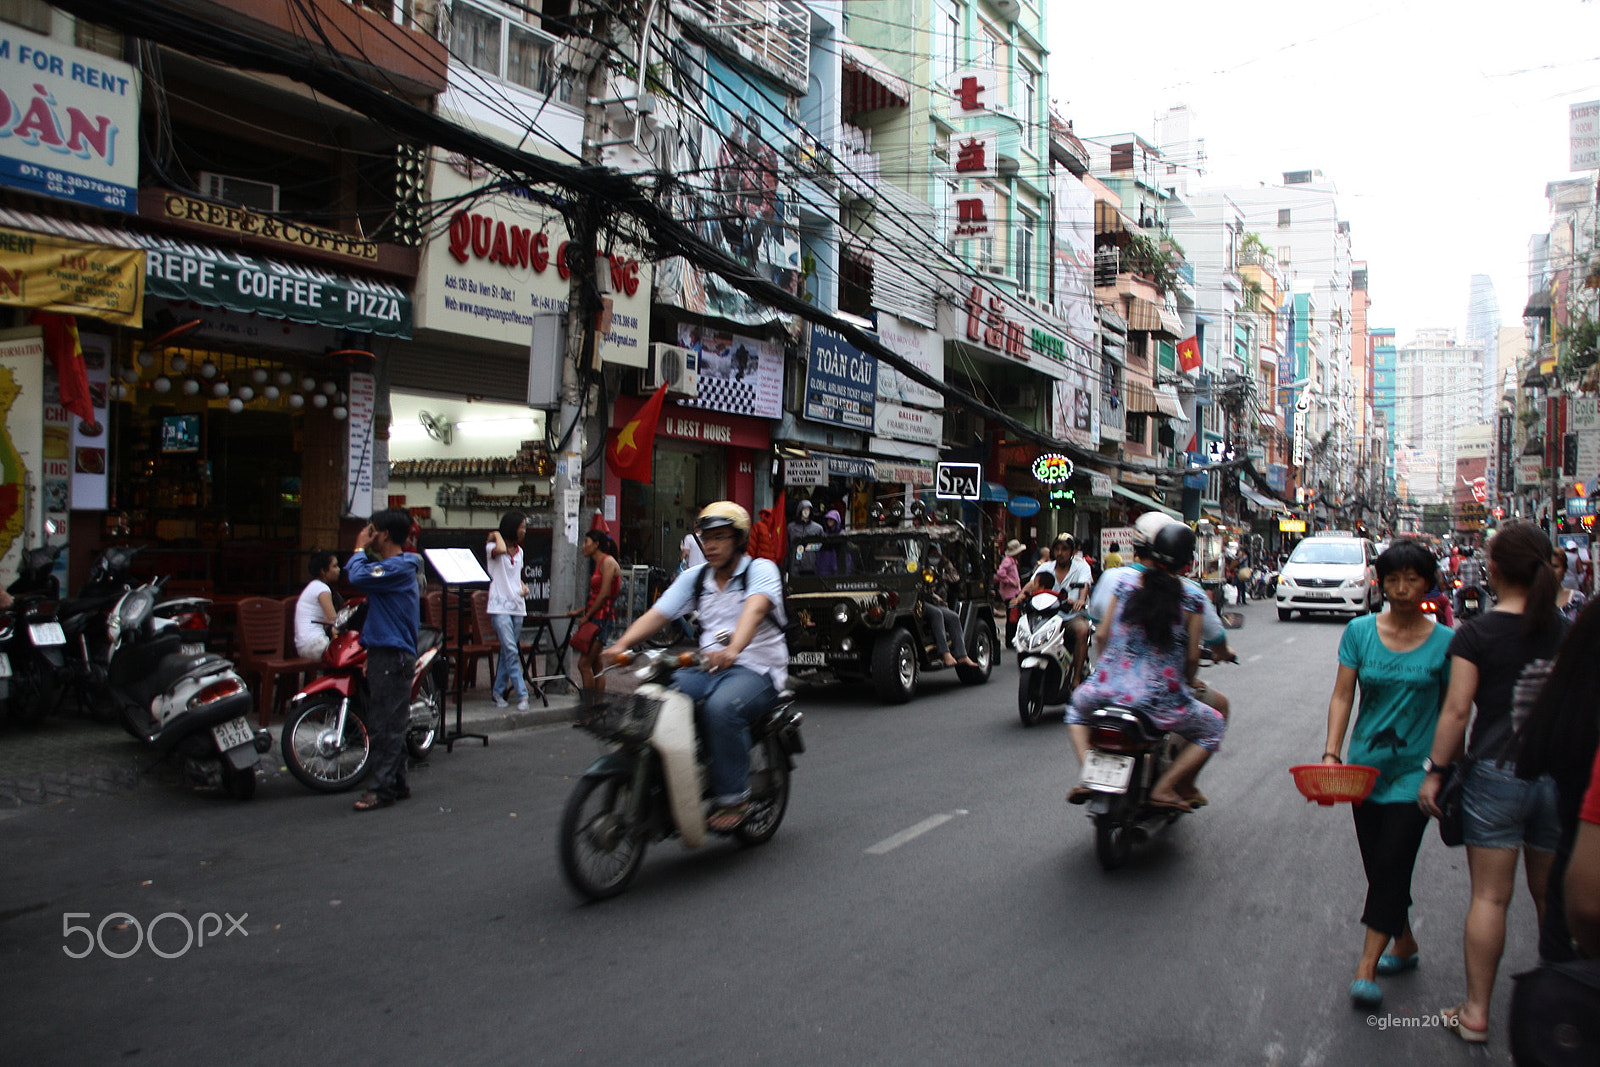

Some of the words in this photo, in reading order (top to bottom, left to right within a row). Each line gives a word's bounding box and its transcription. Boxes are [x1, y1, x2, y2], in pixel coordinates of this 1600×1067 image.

[19, 45, 64, 76] FOR
[71, 62, 129, 96] RENT
[104, 194, 126, 207] 401
[448, 209, 550, 274] QUANG
[146, 250, 215, 288] REPE
[238, 267, 323, 308] COFFEE
[347, 289, 401, 322] PIZZA
[817, 345, 848, 379] TOÀN
[850, 351, 873, 386] CẦU
[810, 377, 828, 392] GLOBAL
[1575, 400, 1595, 415] Cold
[667, 417, 700, 438] U.BEST
[703, 423, 731, 442] HOUSE
[525, 565, 543, 578] Café
[835, 582, 878, 590] RUGGED
